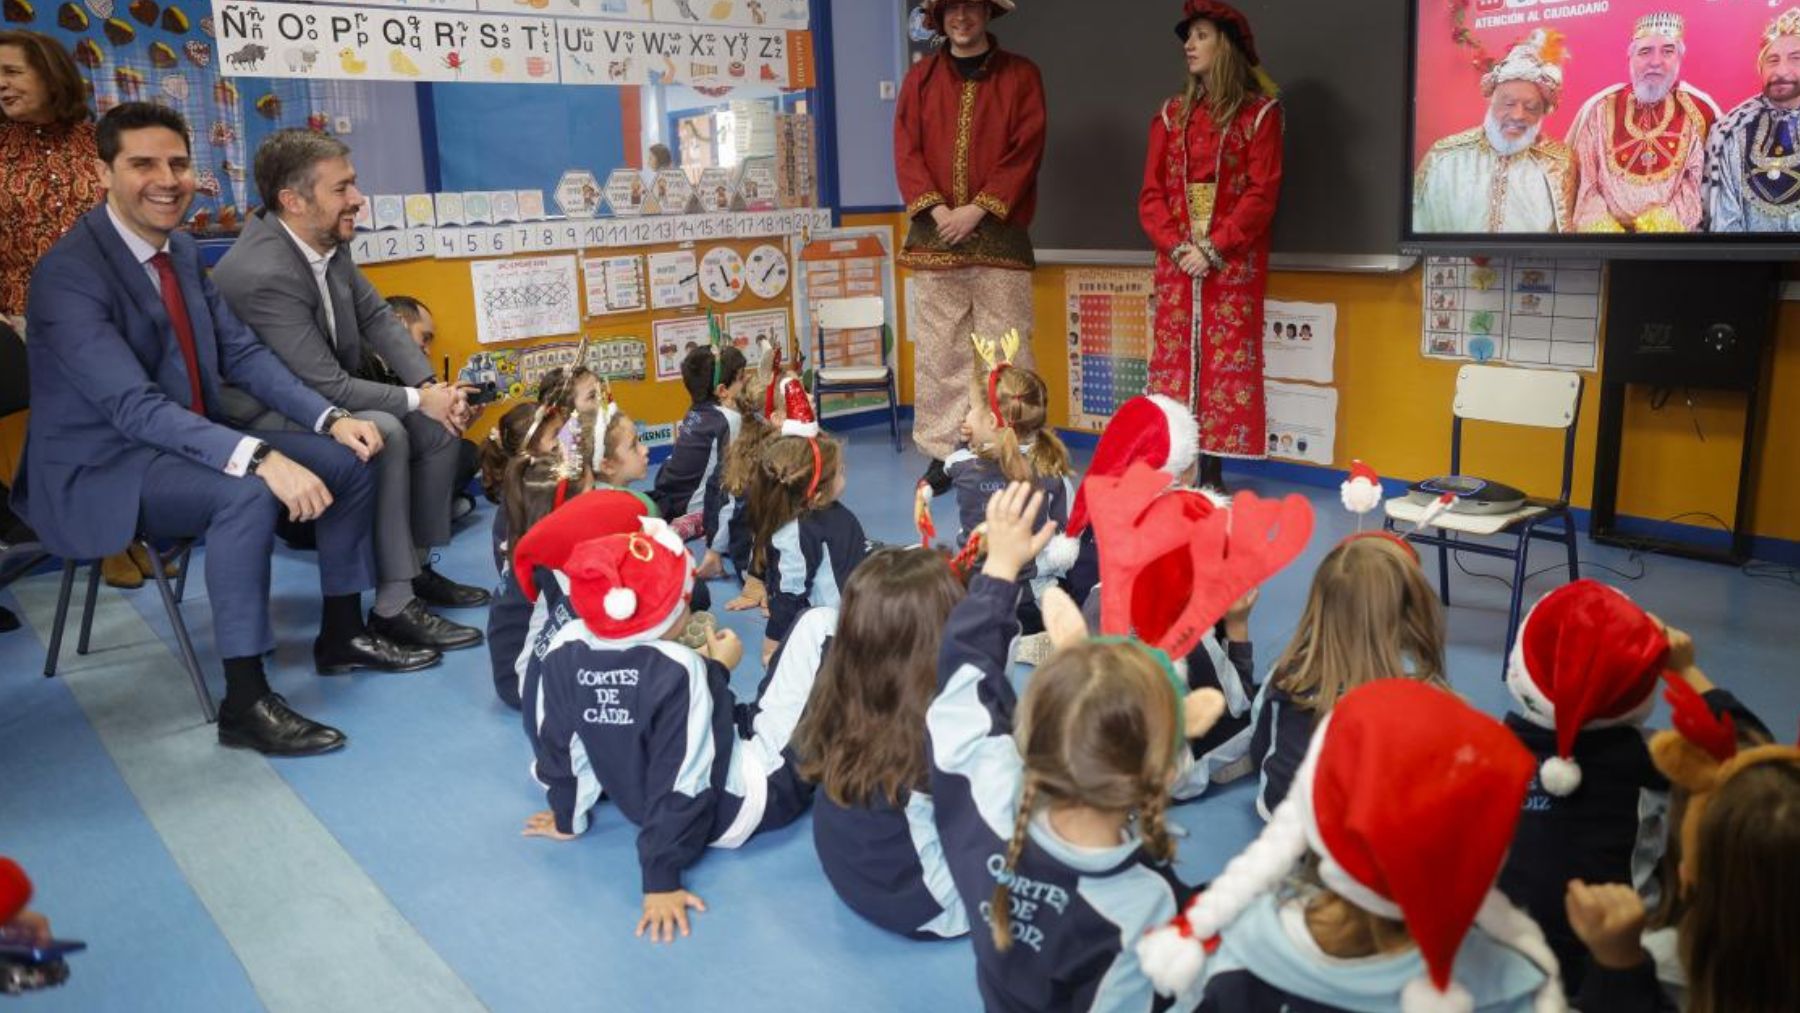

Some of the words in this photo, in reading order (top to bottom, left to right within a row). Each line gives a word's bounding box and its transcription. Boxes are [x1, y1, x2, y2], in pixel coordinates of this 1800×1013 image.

[222, 5, 248, 39] Ñ
[278, 13, 303, 40] O
[1475, 13, 1524, 29] ATENCIÓN
[1527, 11, 1540, 22] AL
[1544, 2, 1609, 19] CIUDADANO
[331, 16, 351, 42] P
[382, 19, 406, 46] Q
[434, 22, 455, 47] R
[480, 23, 498, 48] S
[521, 26, 538, 50] T
[564, 28, 581, 51] U
[603, 30, 621, 53] V
[642, 32, 666, 54] W
[689, 33, 705, 56] X
[723, 36, 738, 57] Y
[759, 37, 773, 58] Z
[358, 240, 370, 258] 1
[386, 237, 398, 256] 2
[414, 234, 426, 252] 3
[442, 236, 454, 253] 4
[467, 234, 478, 252] 5
[493, 233, 504, 250] 6
[519, 230, 529, 247] 7
[543, 229, 553, 246] 8
[567, 228, 577, 243] 9
[584, 225, 605, 243] 10
[607, 225, 629, 242] 11
[632, 222, 650, 241] 12
[653, 222, 671, 239] 13
[676, 219, 694, 236] 14
[698, 219, 714, 236] 15
[716, 217, 734, 235] 16
[737, 217, 755, 234] 17
[757, 215, 774, 232] 18
[777, 215, 792, 231] 19
[812, 213, 829, 229] 21
[577, 668, 639, 686] CORTES
[595, 688, 620, 705] DE
